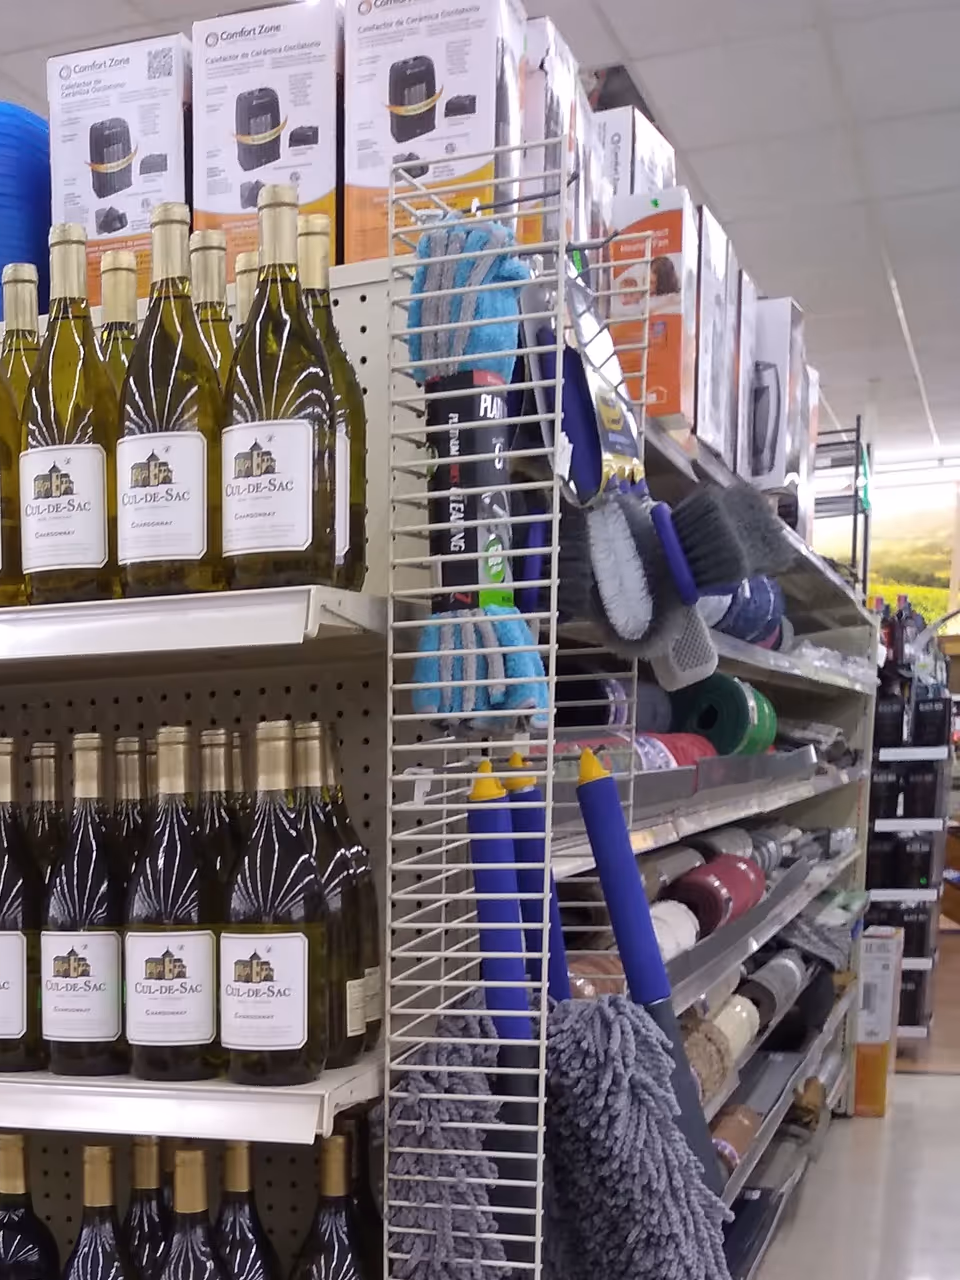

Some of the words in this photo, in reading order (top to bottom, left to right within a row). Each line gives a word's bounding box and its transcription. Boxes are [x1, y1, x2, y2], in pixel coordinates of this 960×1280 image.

[220, 27, 256, 41] Comfort
[258, 24, 281, 35] Zone
[74, 61, 107, 74] Comfort
[109, 57, 130, 66] Zone
[225, 478, 294, 497] CUL-DE-SAC
[121, 488, 190, 506] CUL-DE-SAC
[25, 499, 91, 517] CUL-DE-SAC
[45, 979, 106, 992] CUL-DE-SAC
[134, 982, 203, 995] CUL-DE-SAC
[225, 985, 291, 998] CUL-DE-SAC
